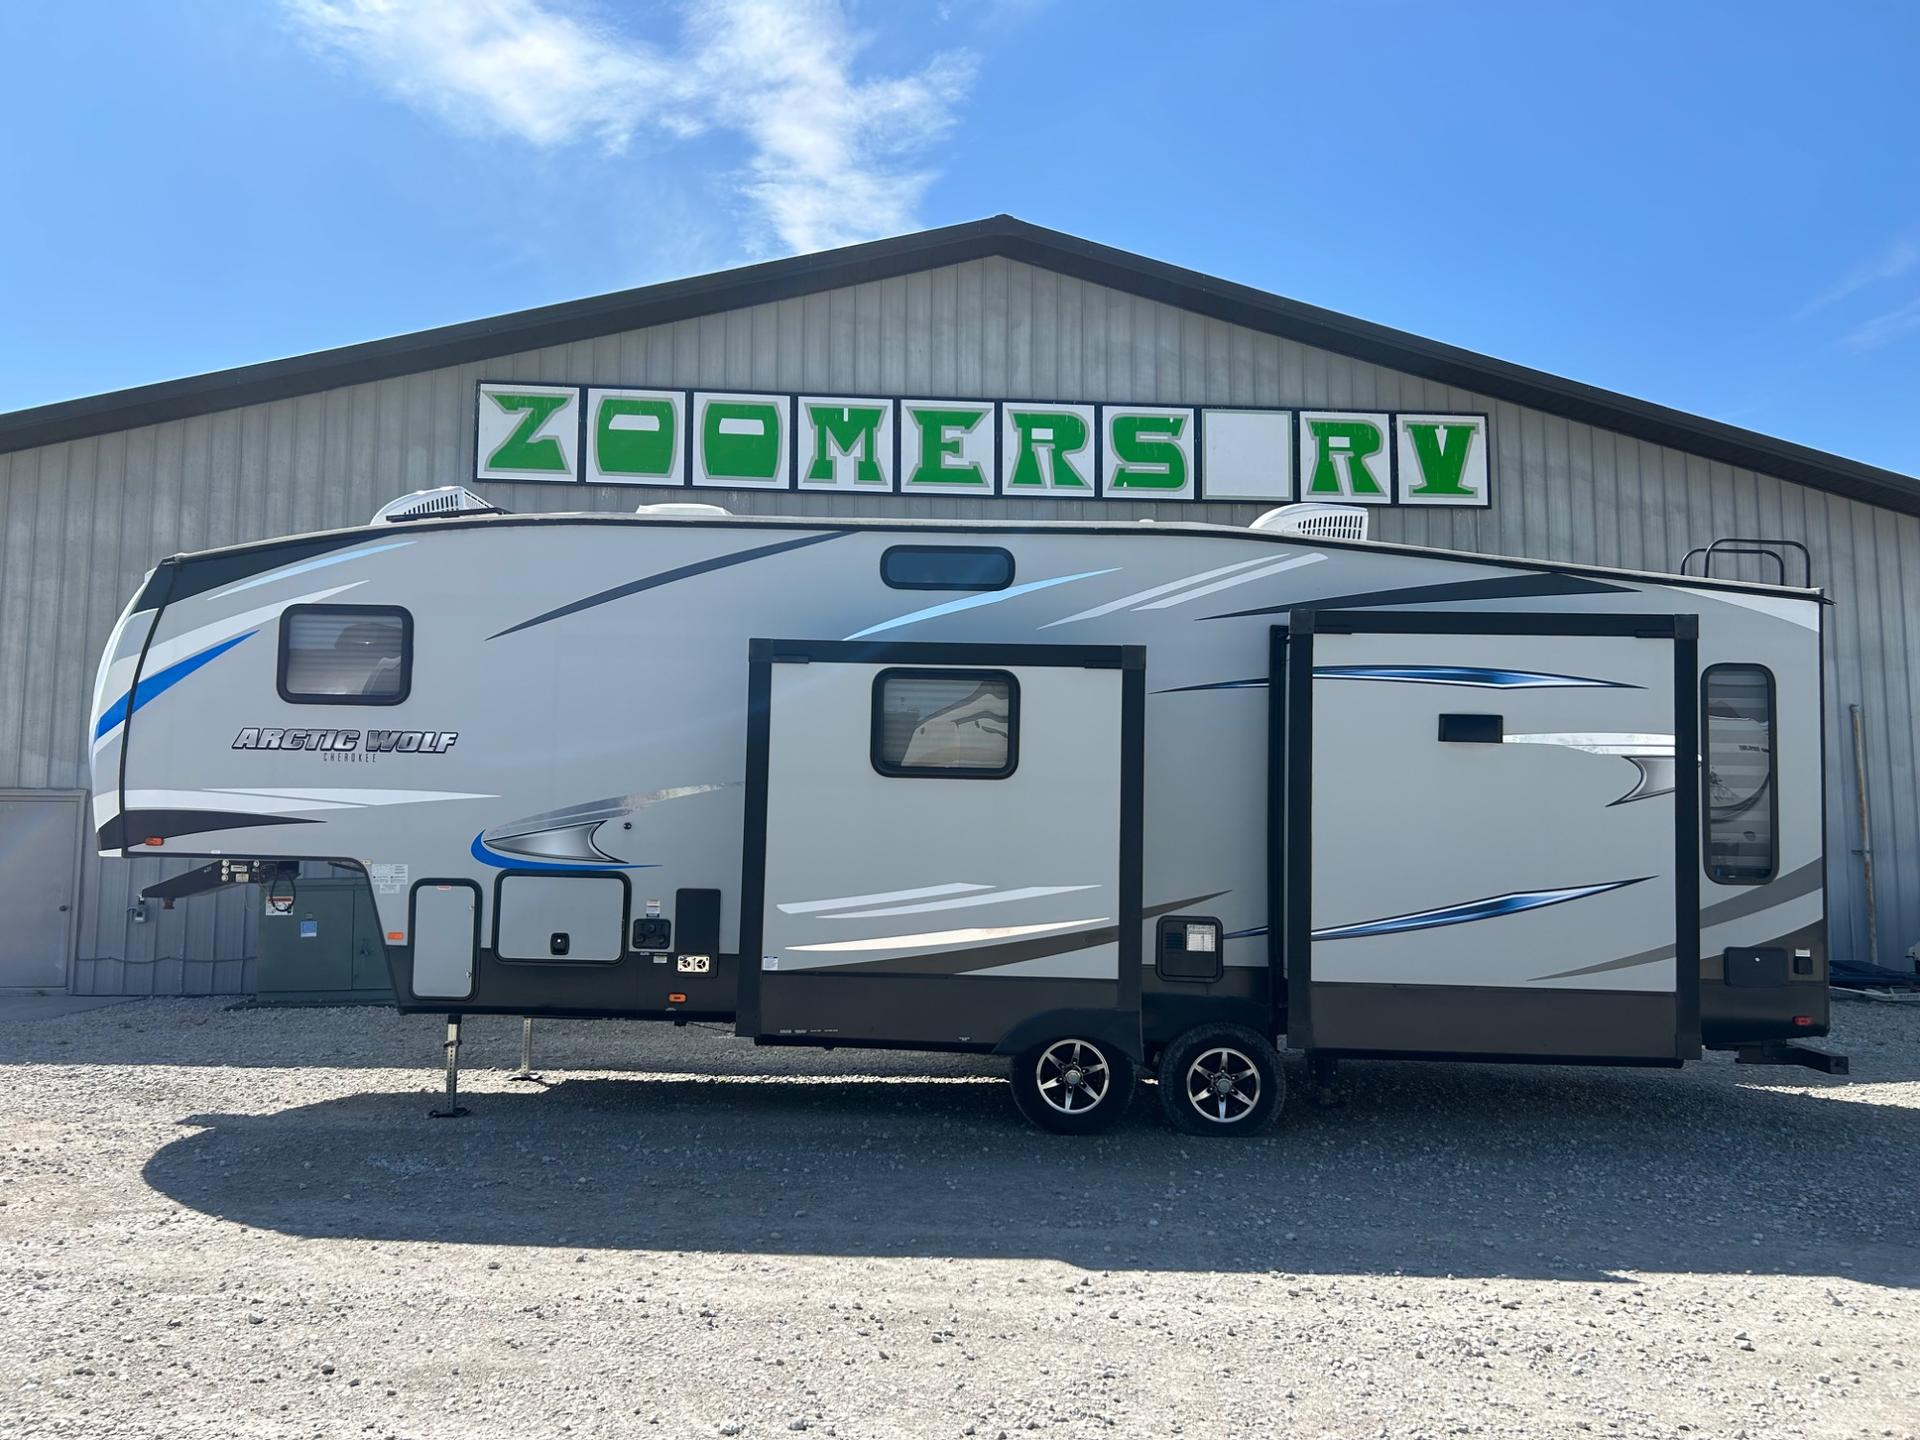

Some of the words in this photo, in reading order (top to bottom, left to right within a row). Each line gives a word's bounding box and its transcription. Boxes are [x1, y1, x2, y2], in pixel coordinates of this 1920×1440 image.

[482, 390, 1190, 492] ZOOMERS
[1304, 416, 1480, 498] RV
[232, 728, 360, 751] ARCTIC
[366, 730, 458, 753] WOLF
[323, 752, 376, 763] CHEROKEE
